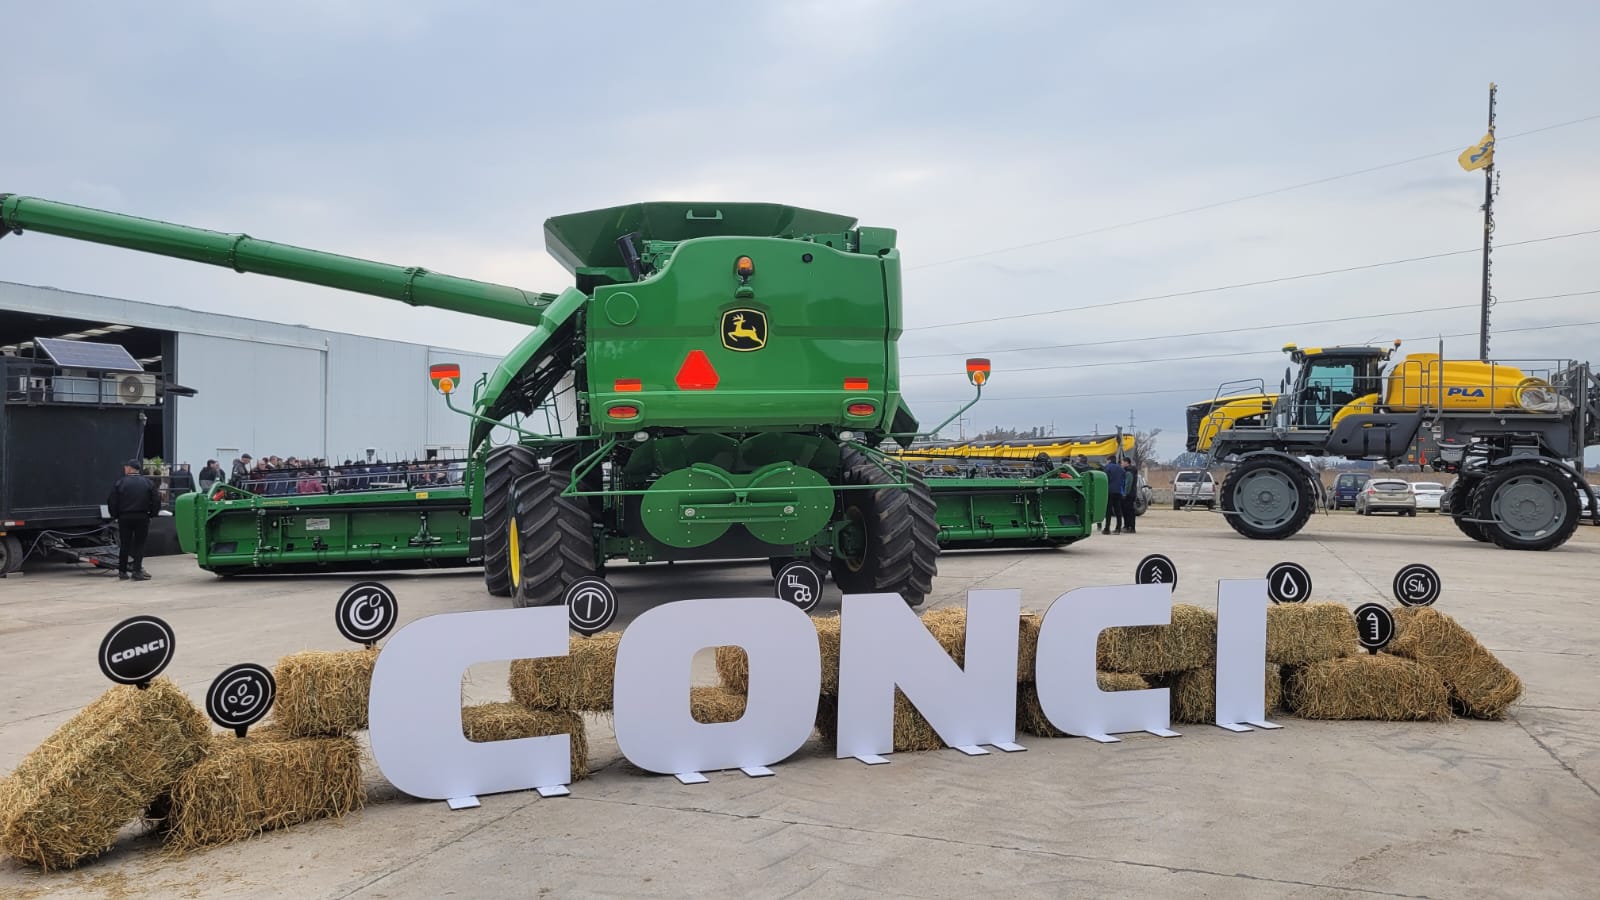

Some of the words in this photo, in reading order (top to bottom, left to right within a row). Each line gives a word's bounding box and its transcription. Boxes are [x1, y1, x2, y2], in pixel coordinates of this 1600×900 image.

[1447, 386, 1485, 398] PLA
[111, 638, 165, 664] CONCI
[368, 578, 1268, 801] CONCI
